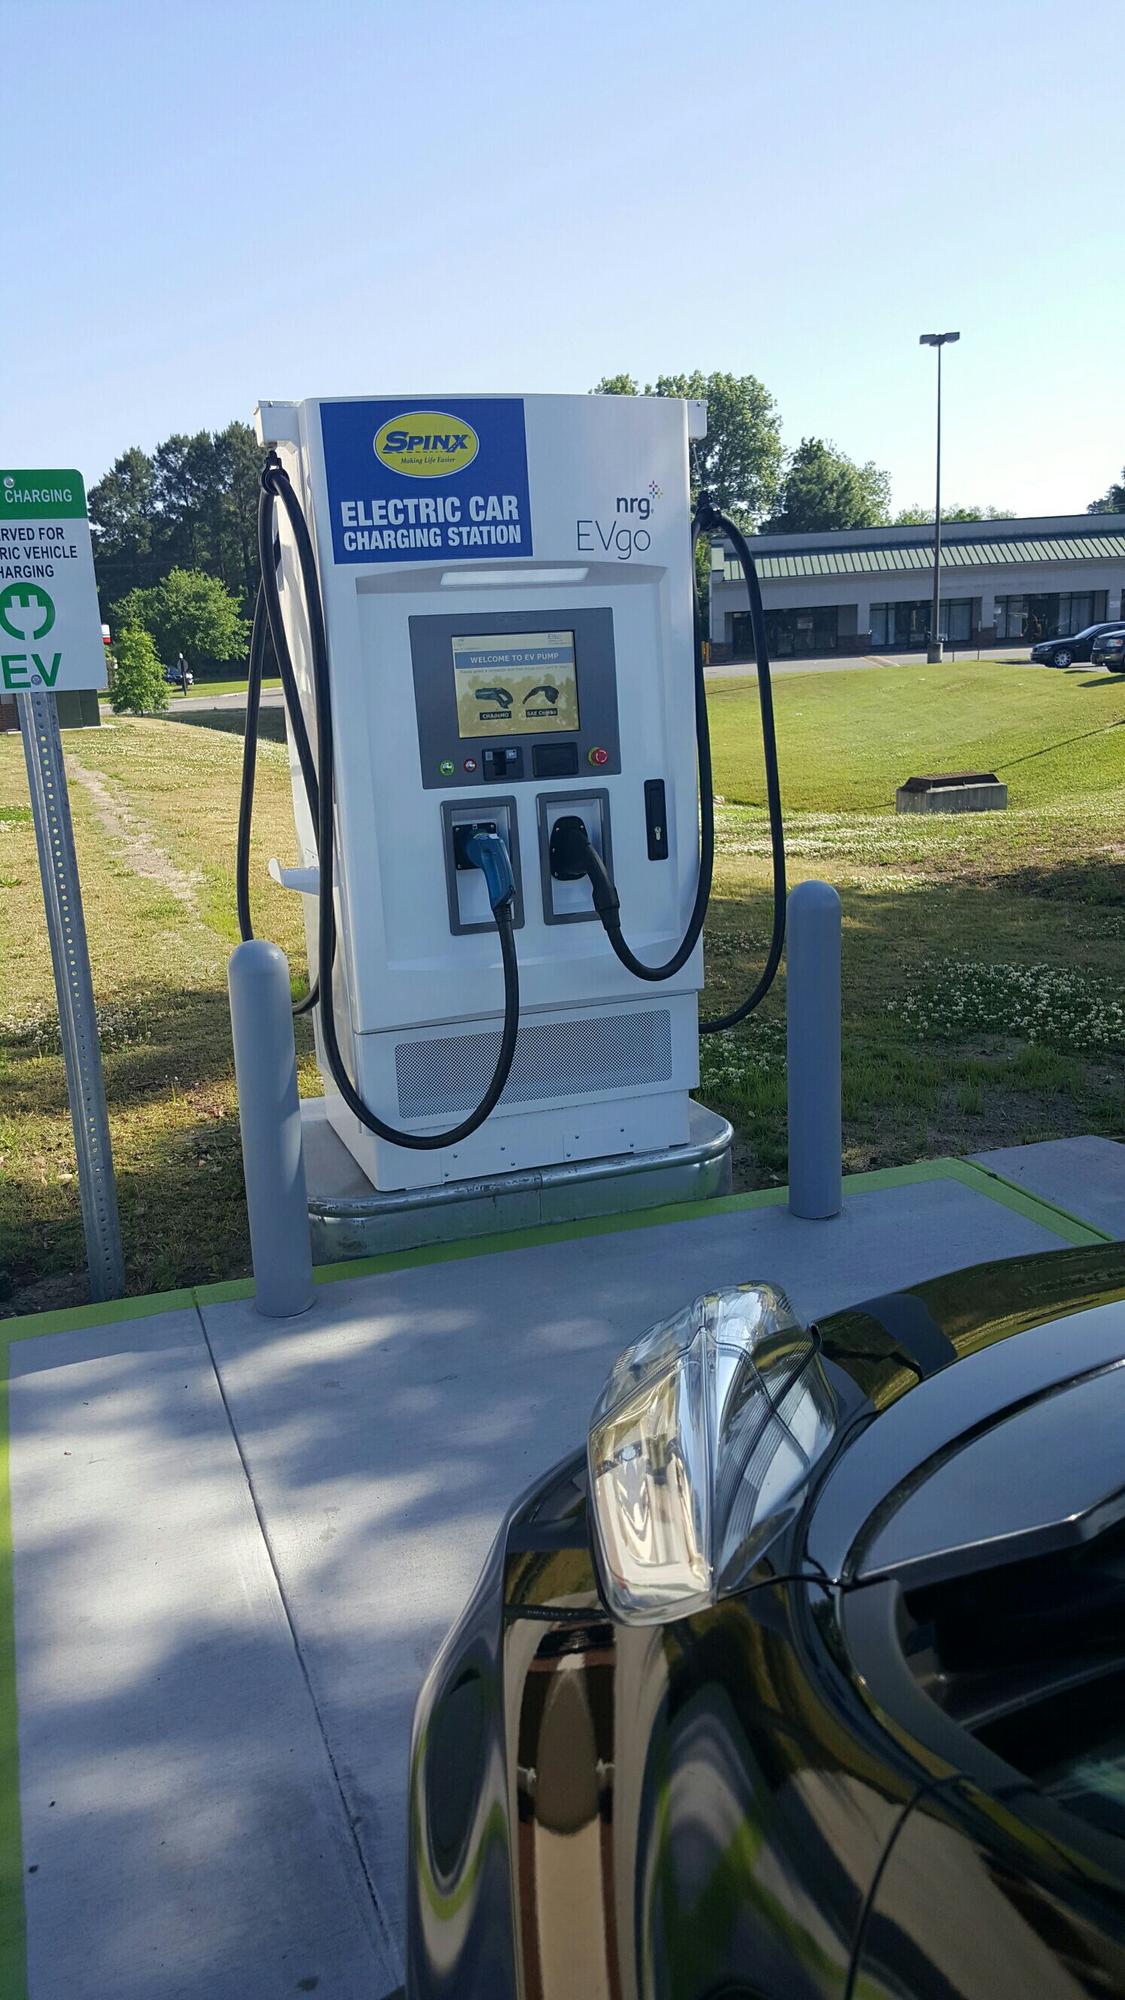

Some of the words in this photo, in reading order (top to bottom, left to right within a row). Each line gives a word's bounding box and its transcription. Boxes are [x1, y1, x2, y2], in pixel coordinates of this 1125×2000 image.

[382, 431, 468, 453] SPINX
[424, 456, 436, 464] Life
[4, 489, 73, 503] CHARGING
[341, 497, 462, 527] ELECTRIC
[469, 495, 519, 522] CAR
[616, 497, 651, 520] nrg
[0, 528, 35, 541] RVED
[39, 527, 64, 540] FOR
[343, 528, 442, 551] CHARGING
[447, 524, 522, 547] STATION
[576, 520, 651, 560] EVgo
[23, 545, 78, 559] VEHICLE
[470, 655, 510, 664] WELCOME
[511, 654, 523, 662] TO
[524, 653, 535, 661] EV
[536, 652, 559, 661] PUMP
[1, 652, 62, 689] EV
